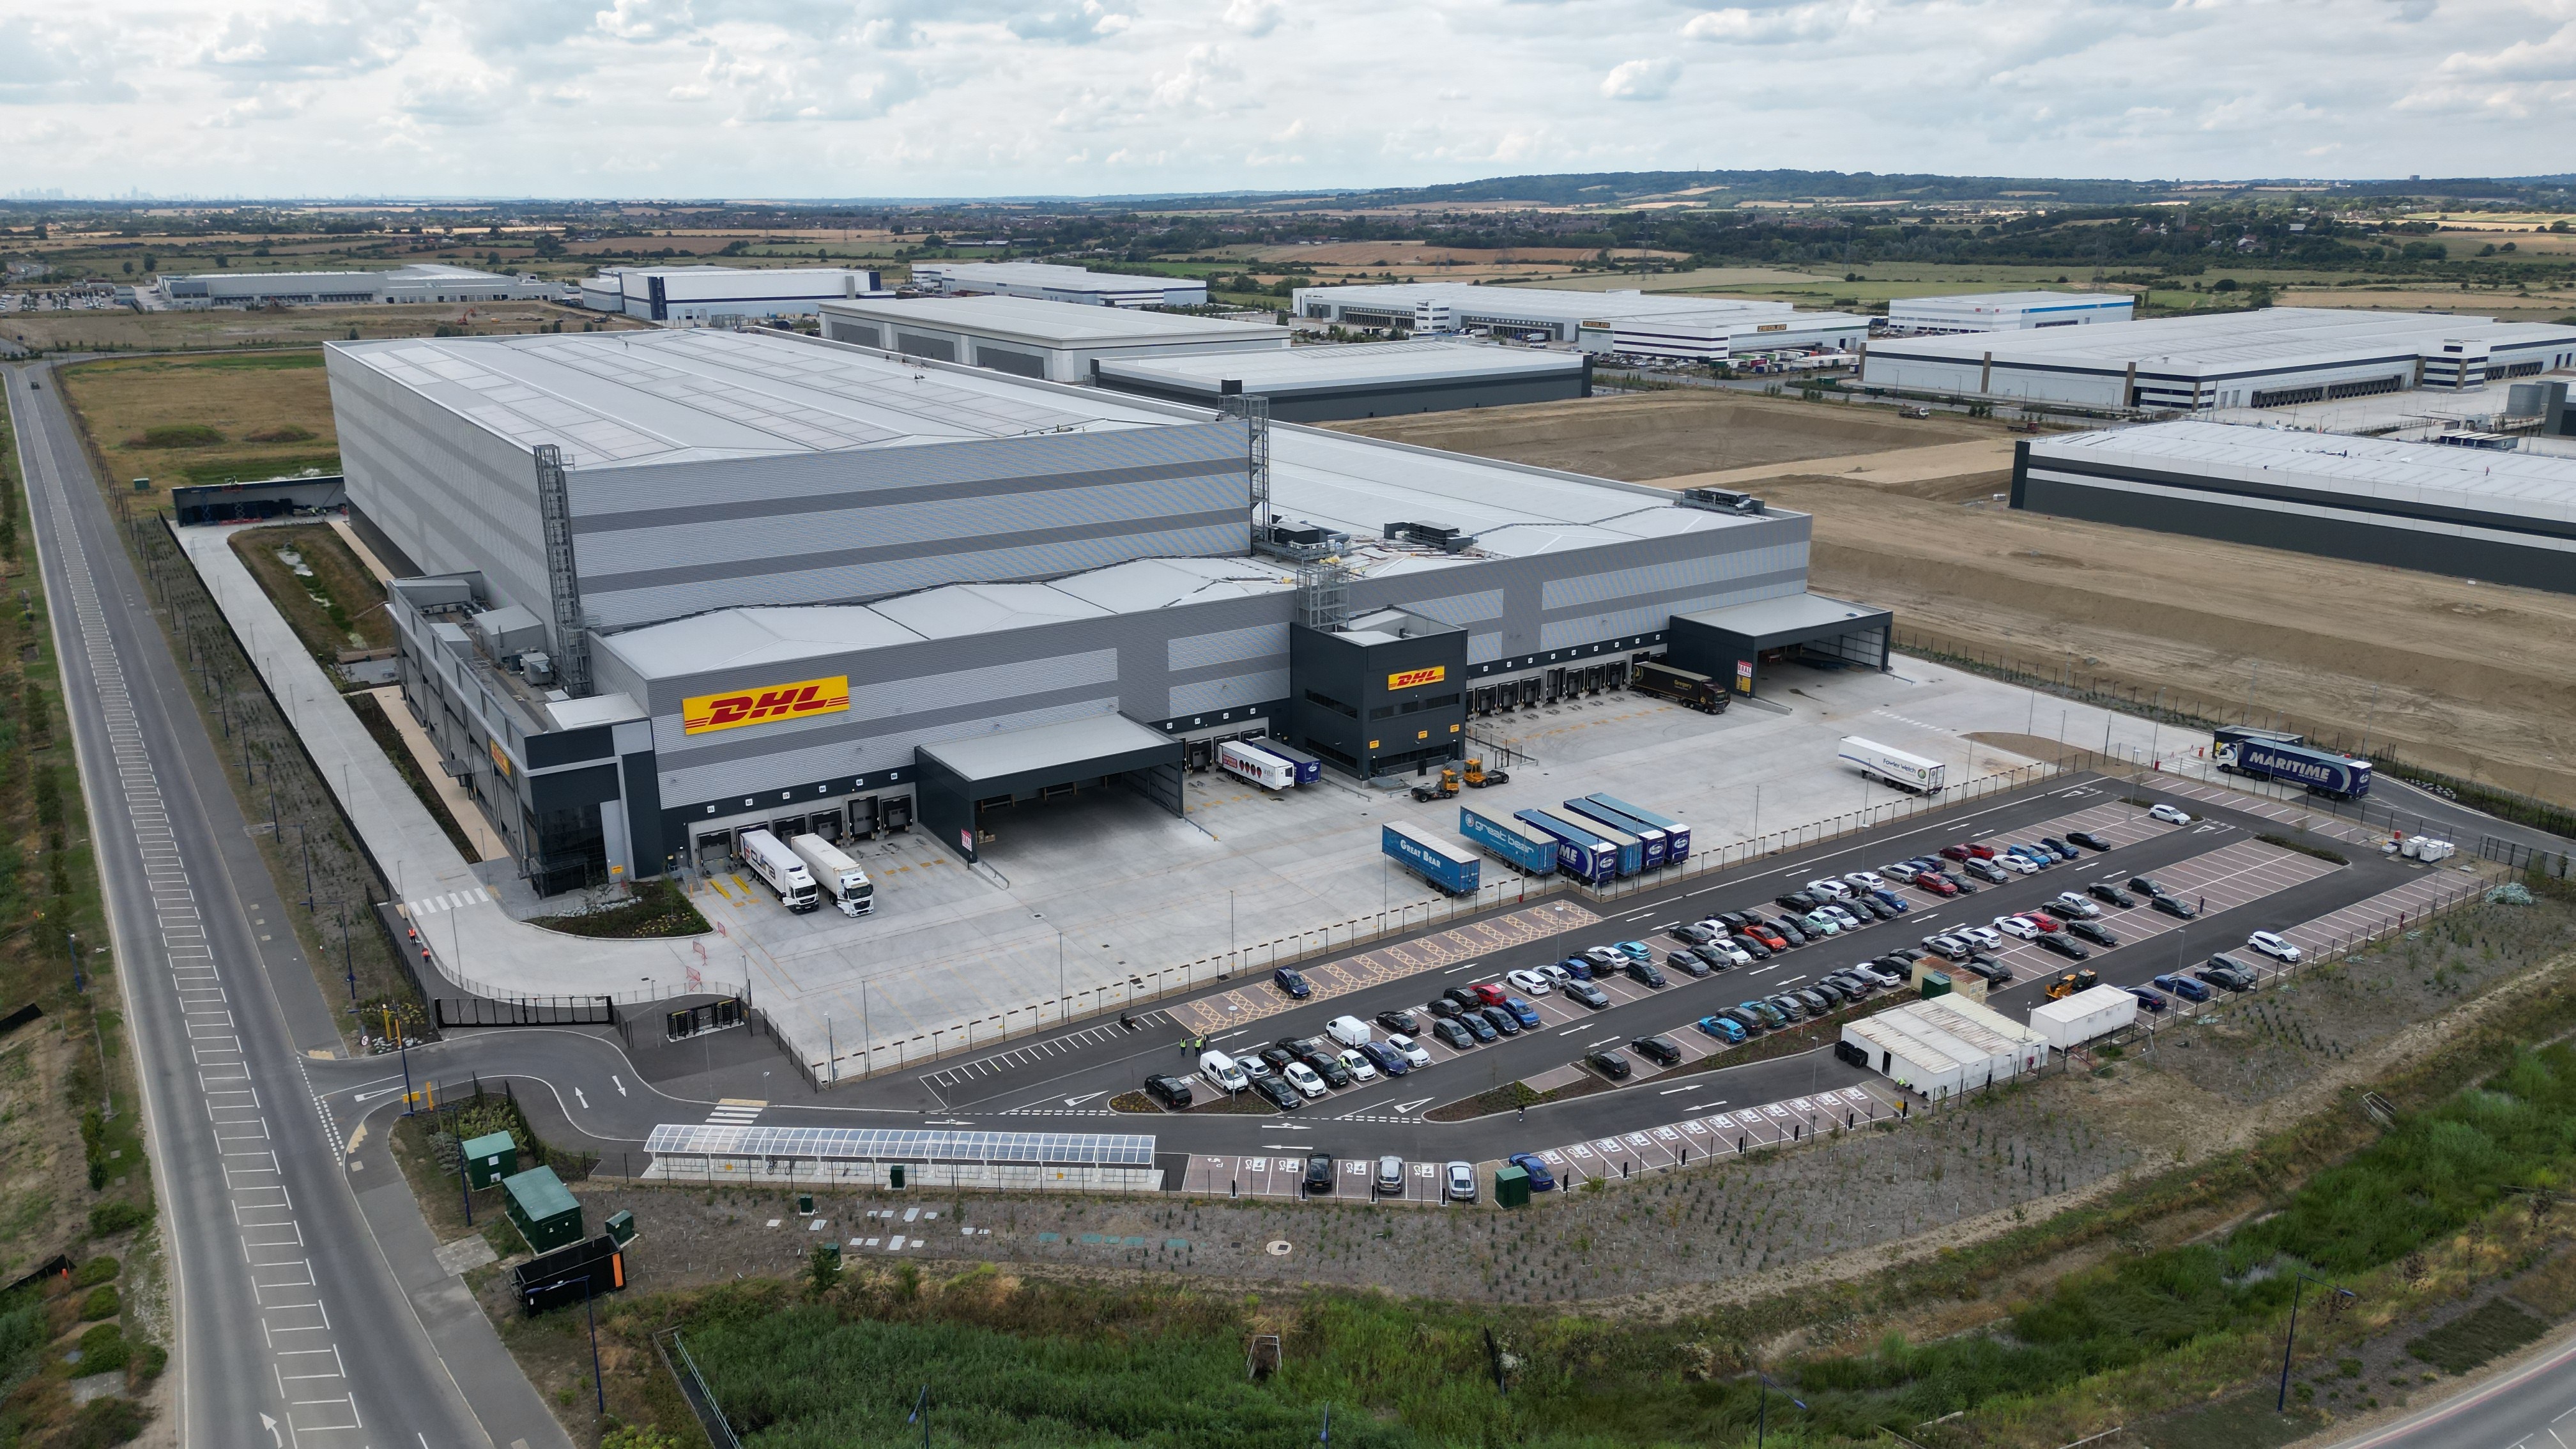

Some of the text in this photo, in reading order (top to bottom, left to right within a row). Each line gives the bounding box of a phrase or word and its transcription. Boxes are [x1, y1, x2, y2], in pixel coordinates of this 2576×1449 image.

[1397, 670, 1437, 686] DHL
[708, 686, 828, 725] DHL
[2249, 752, 2331, 779] MARITIME
[1475, 820, 1506, 841] great
